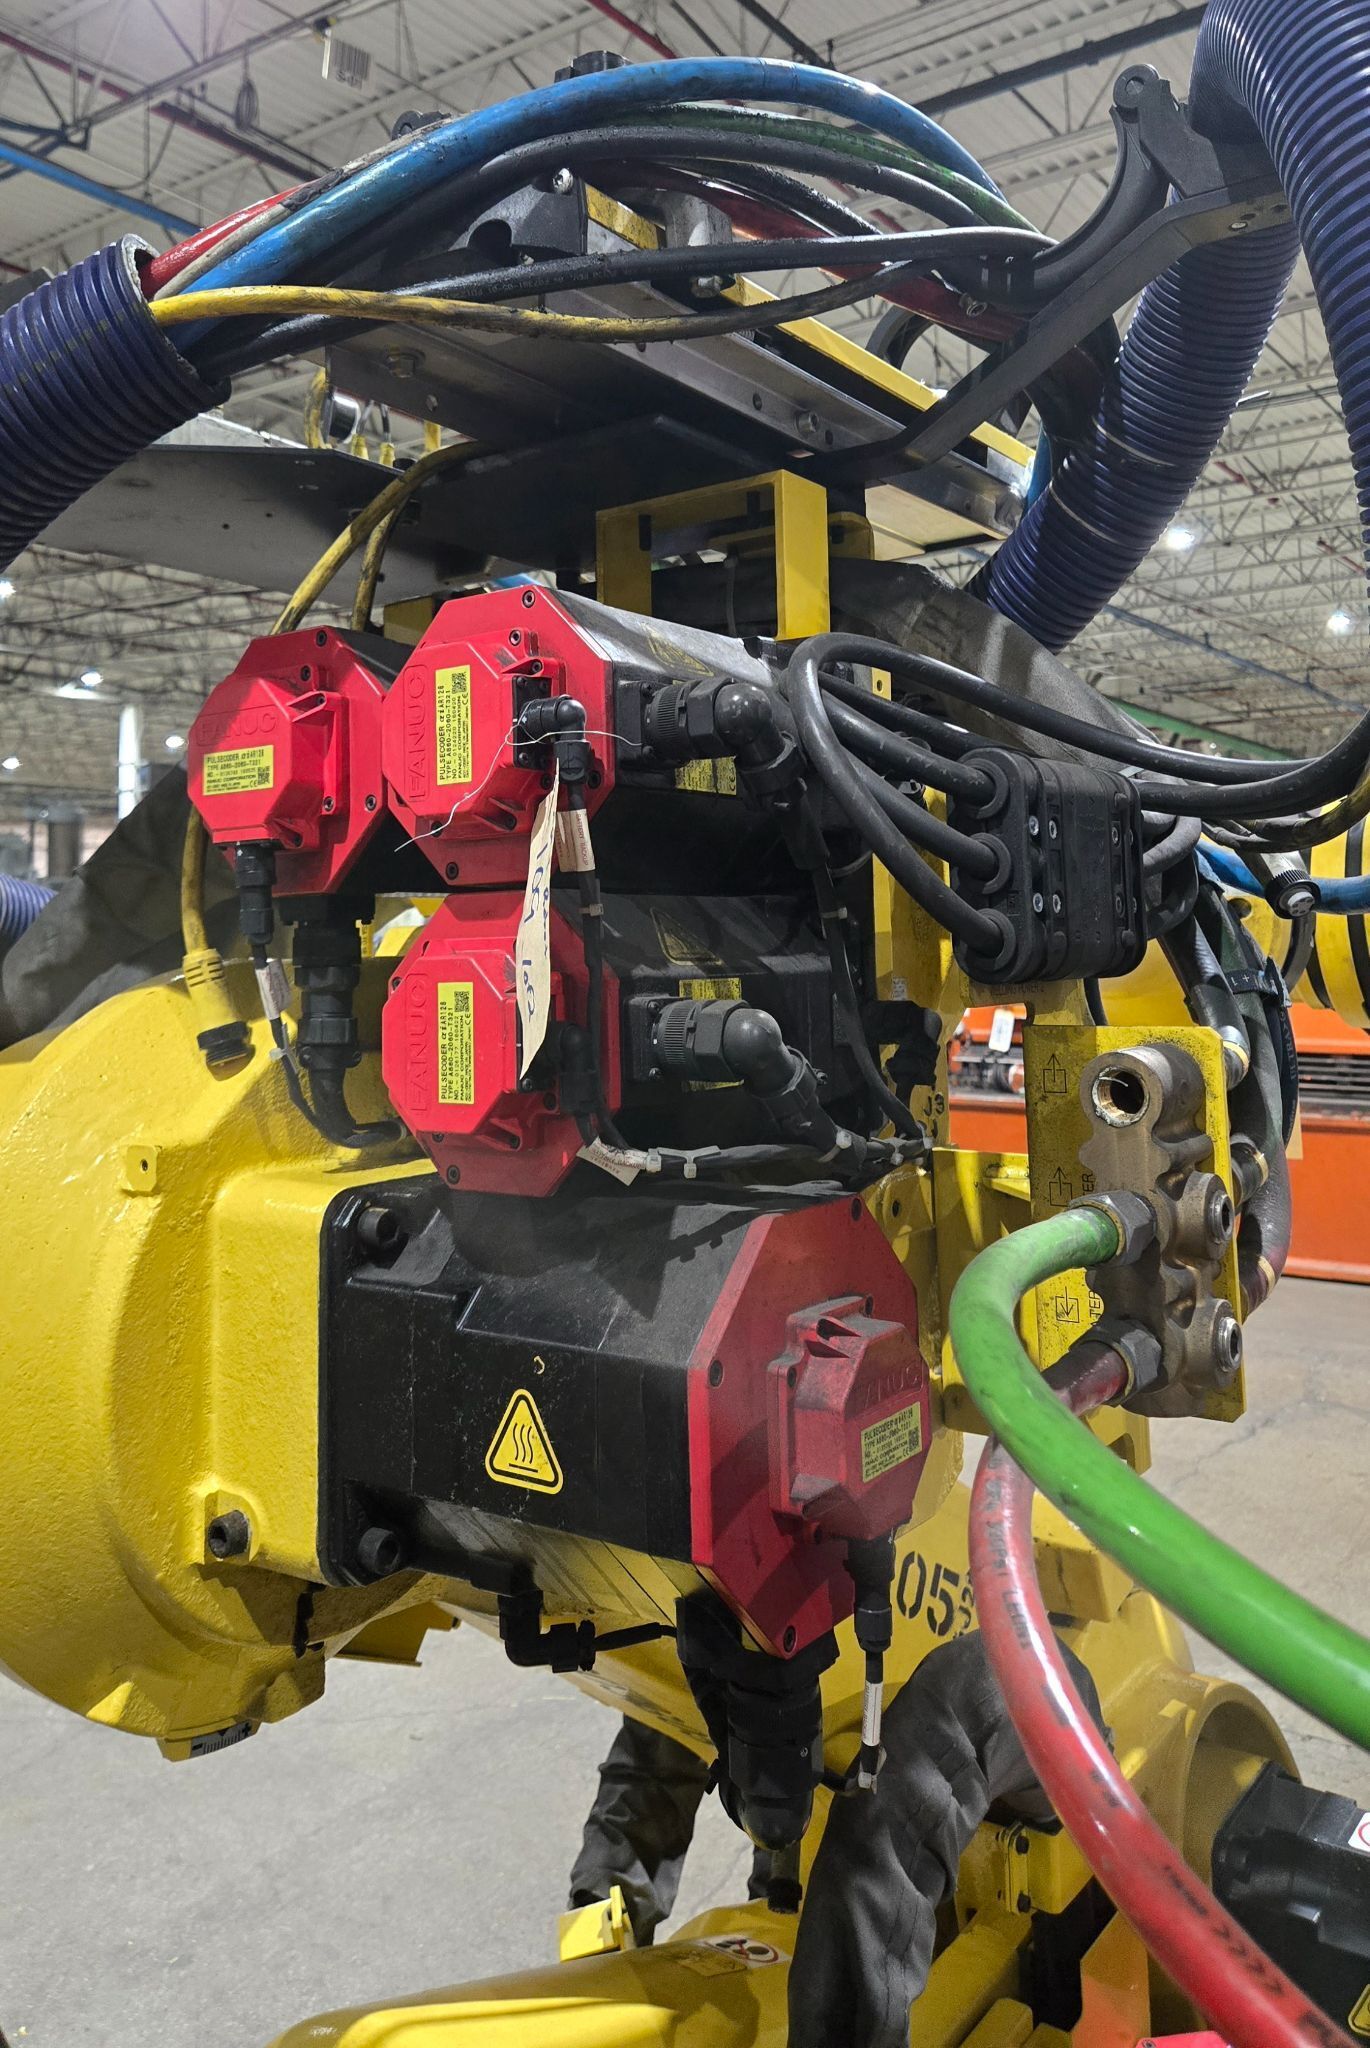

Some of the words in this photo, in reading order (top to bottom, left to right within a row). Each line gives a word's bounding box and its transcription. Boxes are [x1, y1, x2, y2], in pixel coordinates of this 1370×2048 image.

[207, 752, 240, 764] PULSECODER
[408, 675, 426, 799] FANUC
[410, 983, 428, 1113] FANUC
